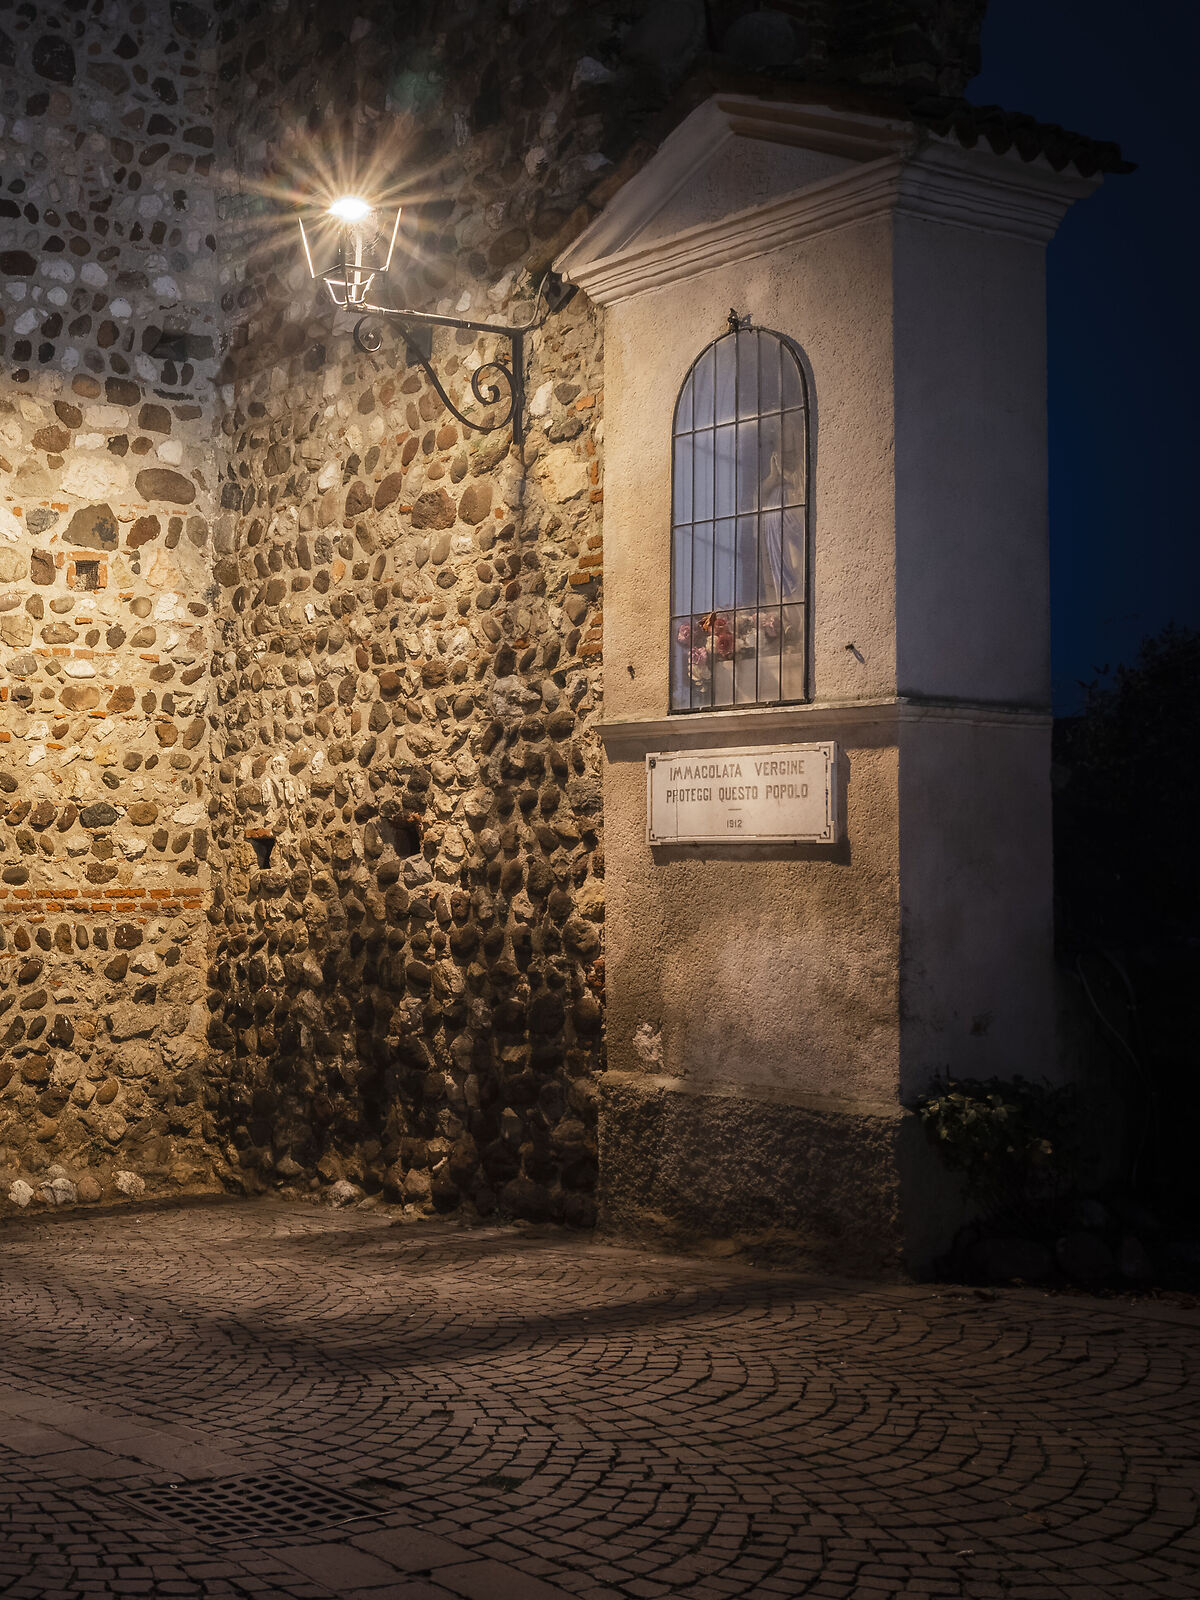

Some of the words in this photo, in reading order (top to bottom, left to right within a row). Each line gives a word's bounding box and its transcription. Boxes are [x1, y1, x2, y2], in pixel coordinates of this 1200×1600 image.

[669, 763, 742, 781] IMMACOLATA
[754, 760, 805, 776] VERGINE
[666, 787, 712, 803] PROTEGGI
[719, 786, 758, 802] QUESTO
[765, 783, 808, 799] POPOLO
[726, 819, 743, 828] 1912
